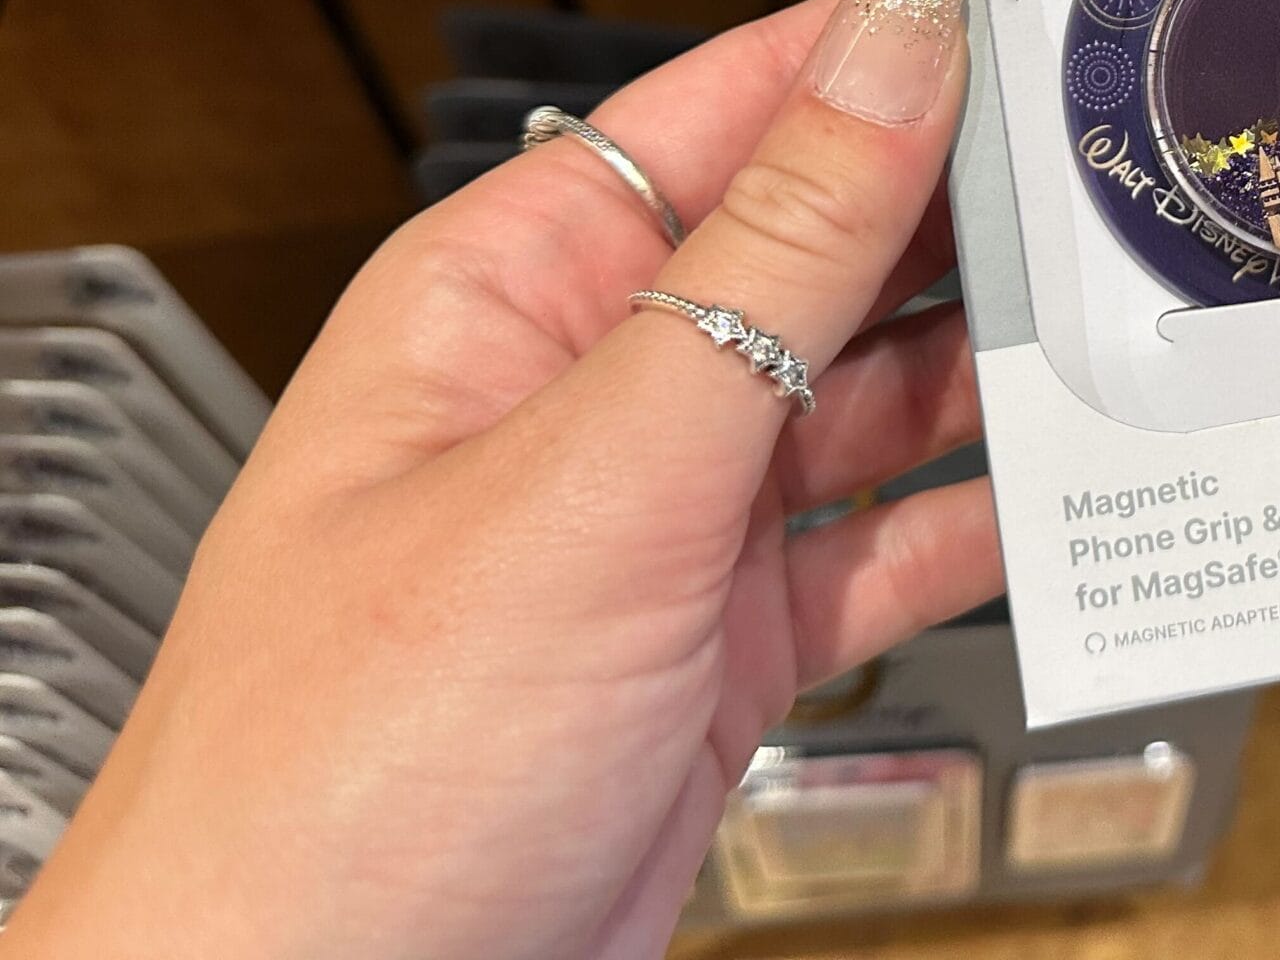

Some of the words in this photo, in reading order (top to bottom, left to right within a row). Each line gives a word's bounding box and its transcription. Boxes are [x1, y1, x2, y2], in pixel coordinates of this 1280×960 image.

[1062, 470, 1219, 522] Magnetic
[1069, 529, 1175, 567] Phone
[1184, 512, 1253, 544] Grip
[1075, 582, 1122, 611] for
[1113, 618, 1206, 648] MAGNETIC
